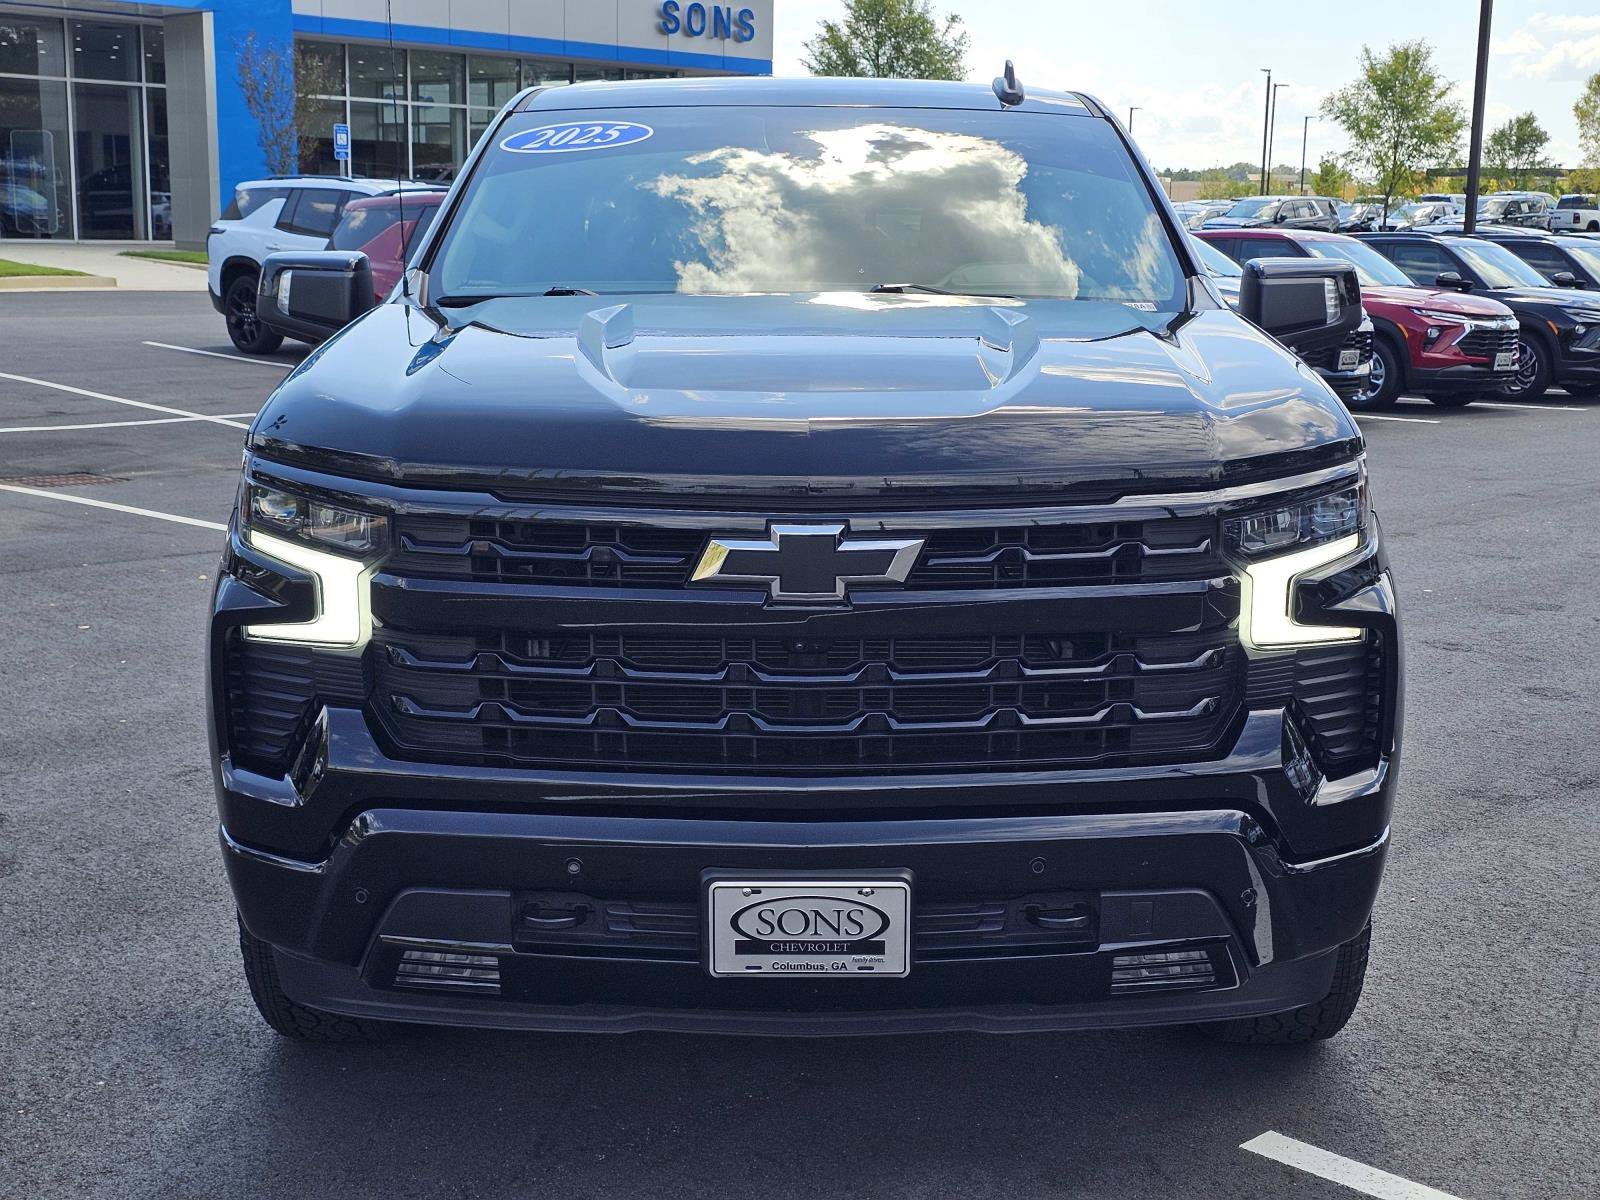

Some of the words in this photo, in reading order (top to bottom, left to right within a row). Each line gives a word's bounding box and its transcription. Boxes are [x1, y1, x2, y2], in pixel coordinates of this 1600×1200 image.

[662, 0, 755, 42] SONS
[520, 125, 631, 149] 2025
[755, 908, 864, 936] SONS
[770, 942, 850, 952] CHEVROLET
[771, 961, 828, 972] Columbus,
[831, 961, 848, 971] GA
